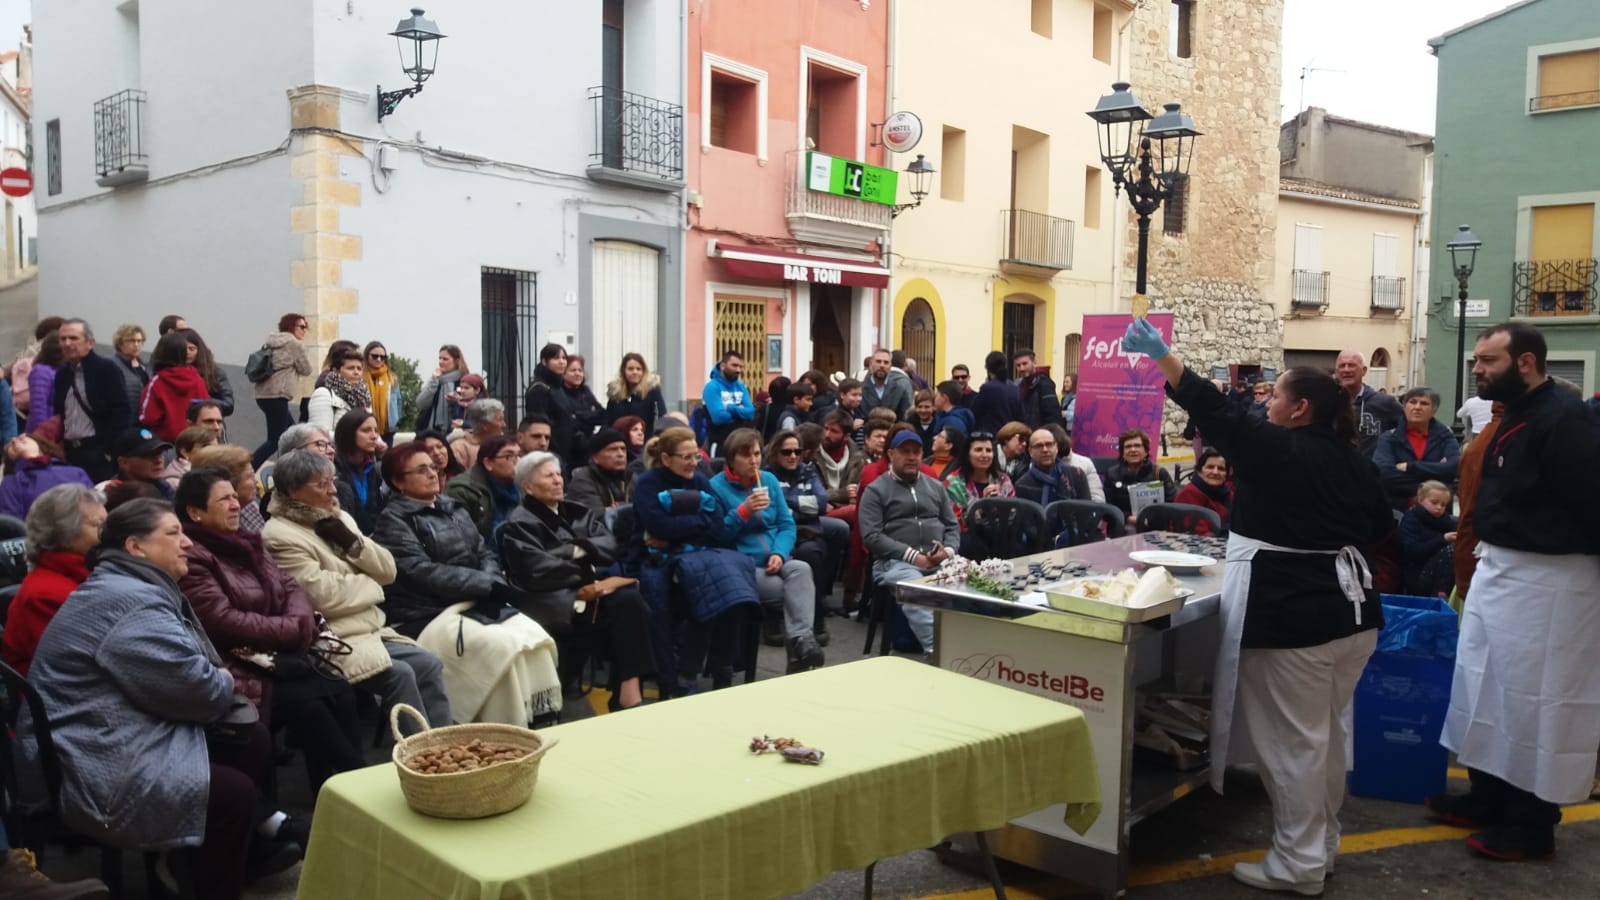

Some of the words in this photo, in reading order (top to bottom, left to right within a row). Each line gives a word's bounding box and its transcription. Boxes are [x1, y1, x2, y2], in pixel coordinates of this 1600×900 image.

[784, 264, 808, 281] BAR
[813, 268, 842, 285] TONI
[998, 661, 1105, 702] hostelBe
